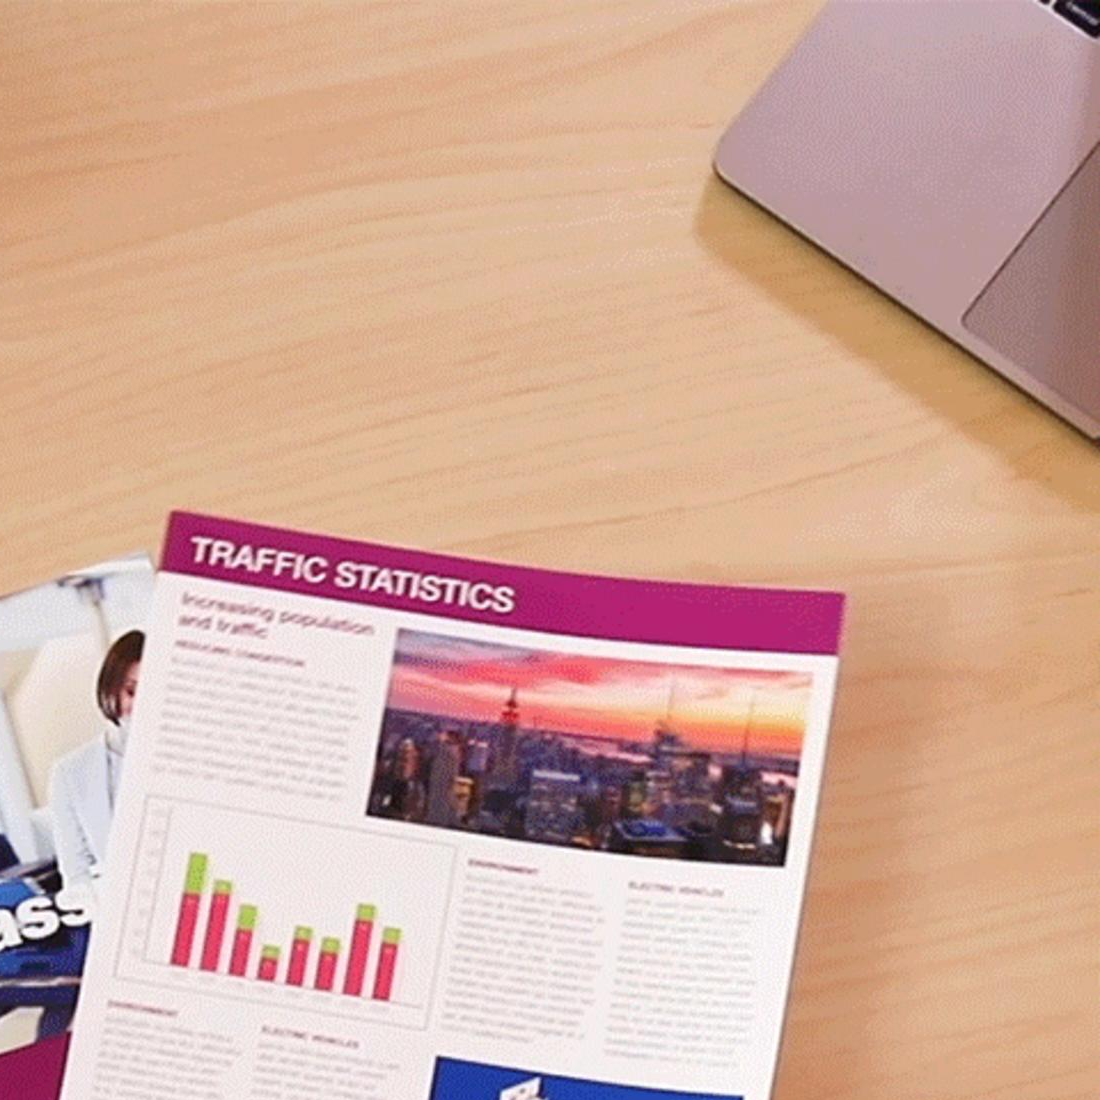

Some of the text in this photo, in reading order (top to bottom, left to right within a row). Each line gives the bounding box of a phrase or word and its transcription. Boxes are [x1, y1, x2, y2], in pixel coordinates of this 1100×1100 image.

[191, 536, 516, 613] TRAFFIC STATISTICS
[178, 611, 269, 641] and traffic
[181, 591, 375, 640] Increasing population
